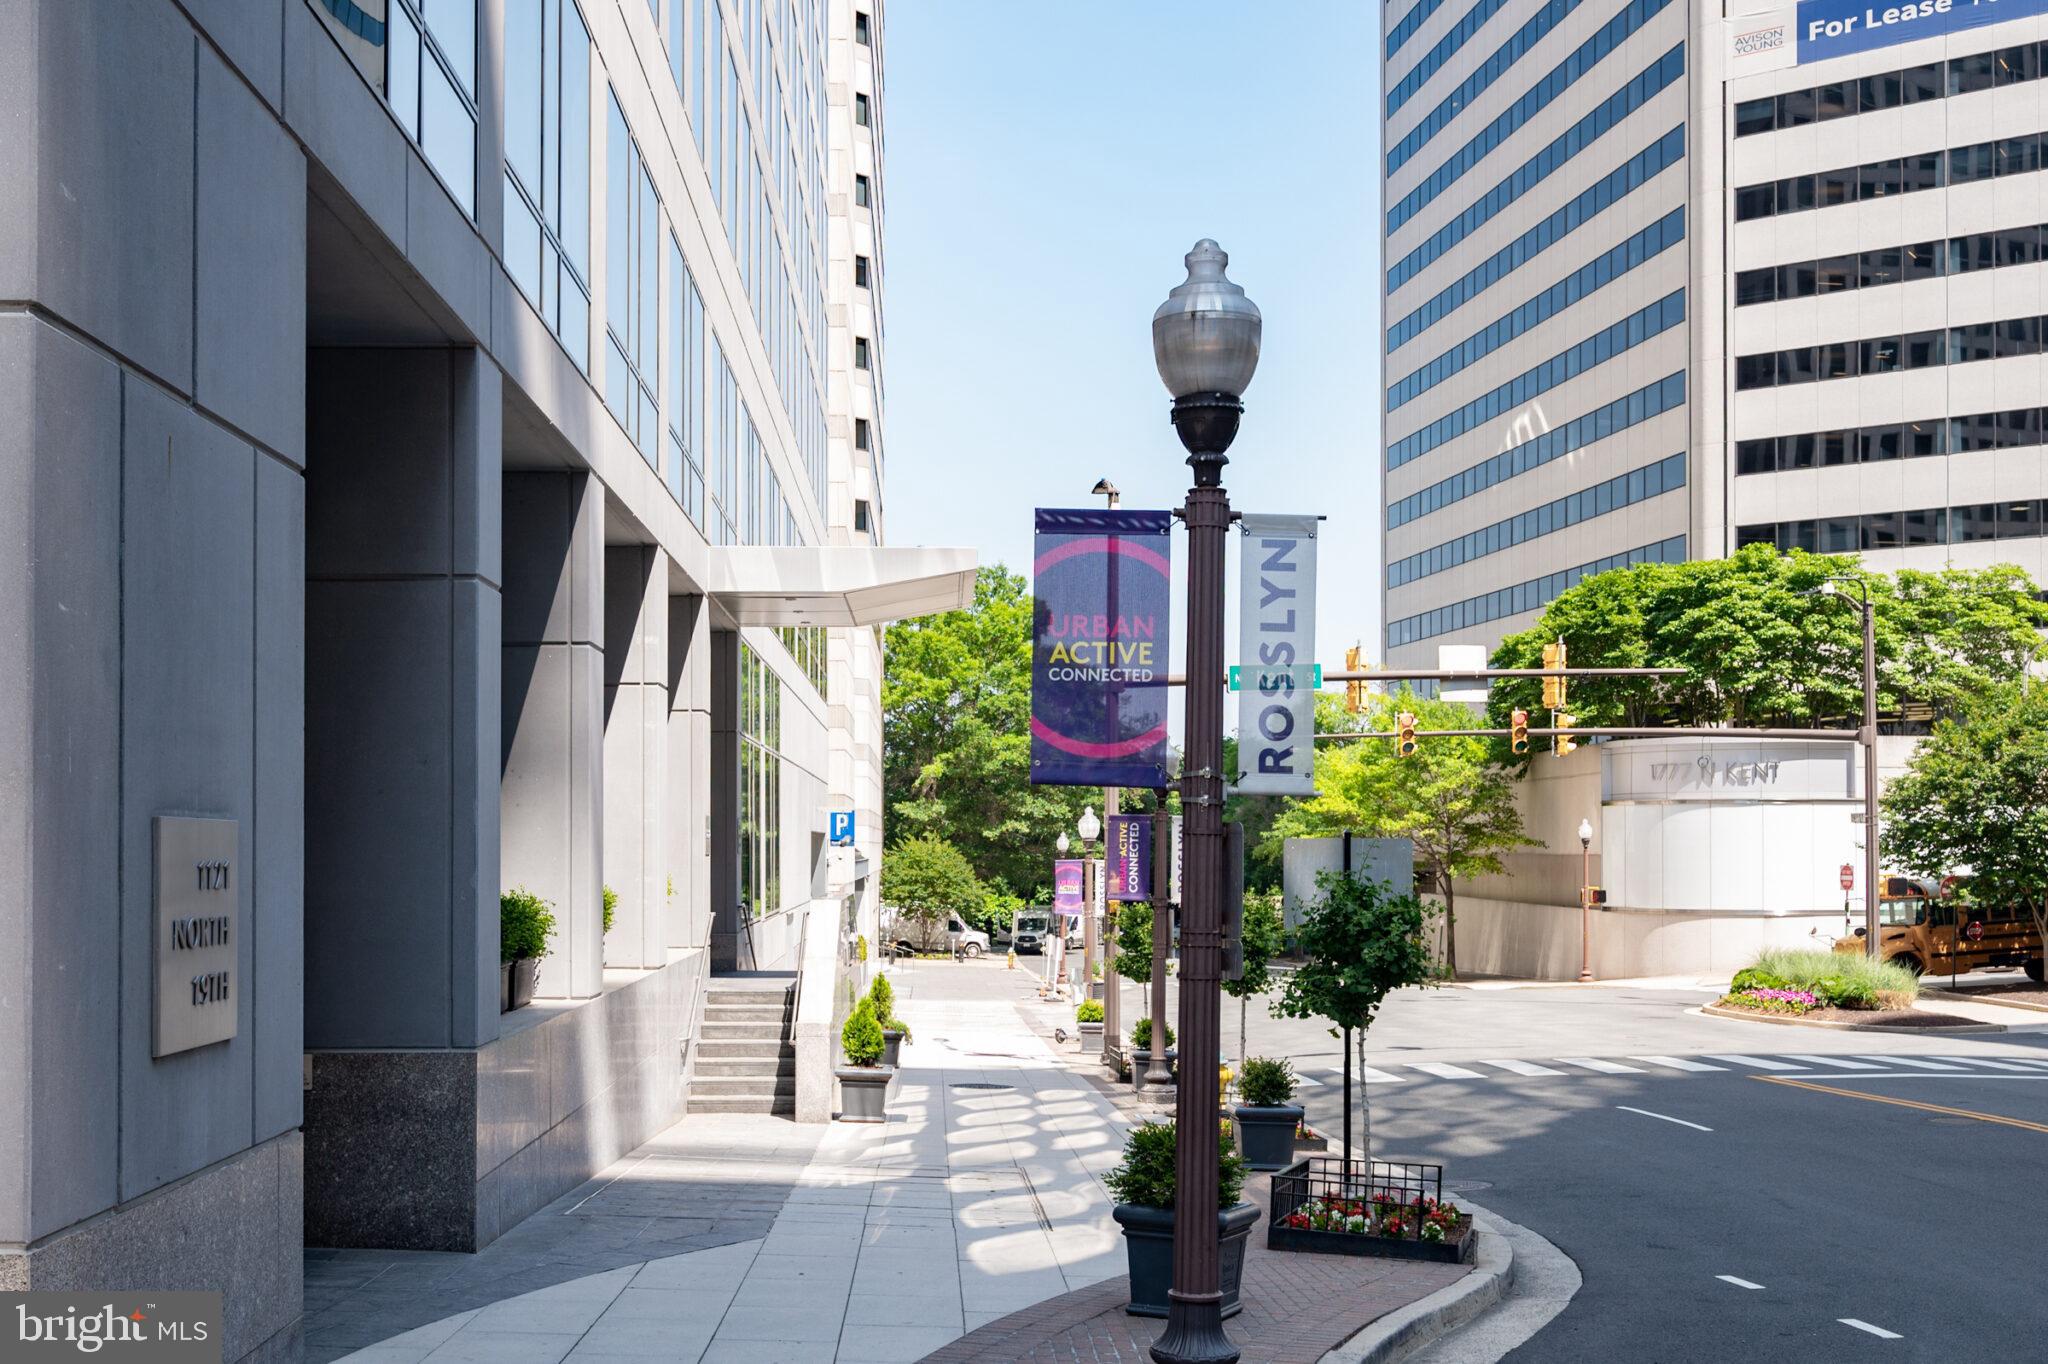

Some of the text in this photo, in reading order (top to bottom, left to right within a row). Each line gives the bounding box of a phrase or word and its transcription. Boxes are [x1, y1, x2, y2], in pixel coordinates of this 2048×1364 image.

[1808, 0, 1952, 42] For Lease
[1734, 28, 1784, 47] AVISON
[1734, 37, 1784, 55] YOUNG
[1048, 613, 1154, 639] URBAN
[1048, 641, 1153, 665] ACTIVE
[1258, 539, 1297, 775] ROSSLYN
[1048, 667, 1153, 683] CONNECTED
[1650, 762, 1692, 781] 1777
[1724, 761, 1780, 785] KENT
[835, 813, 849, 836] P
[1119, 821, 1128, 892] URBAN ACTIVE
[1129, 822, 1140, 894] CONNECTED
[197, 859, 230, 891] 1121
[171, 915, 230, 951] NORTH
[191, 971, 230, 1006] 19TH
